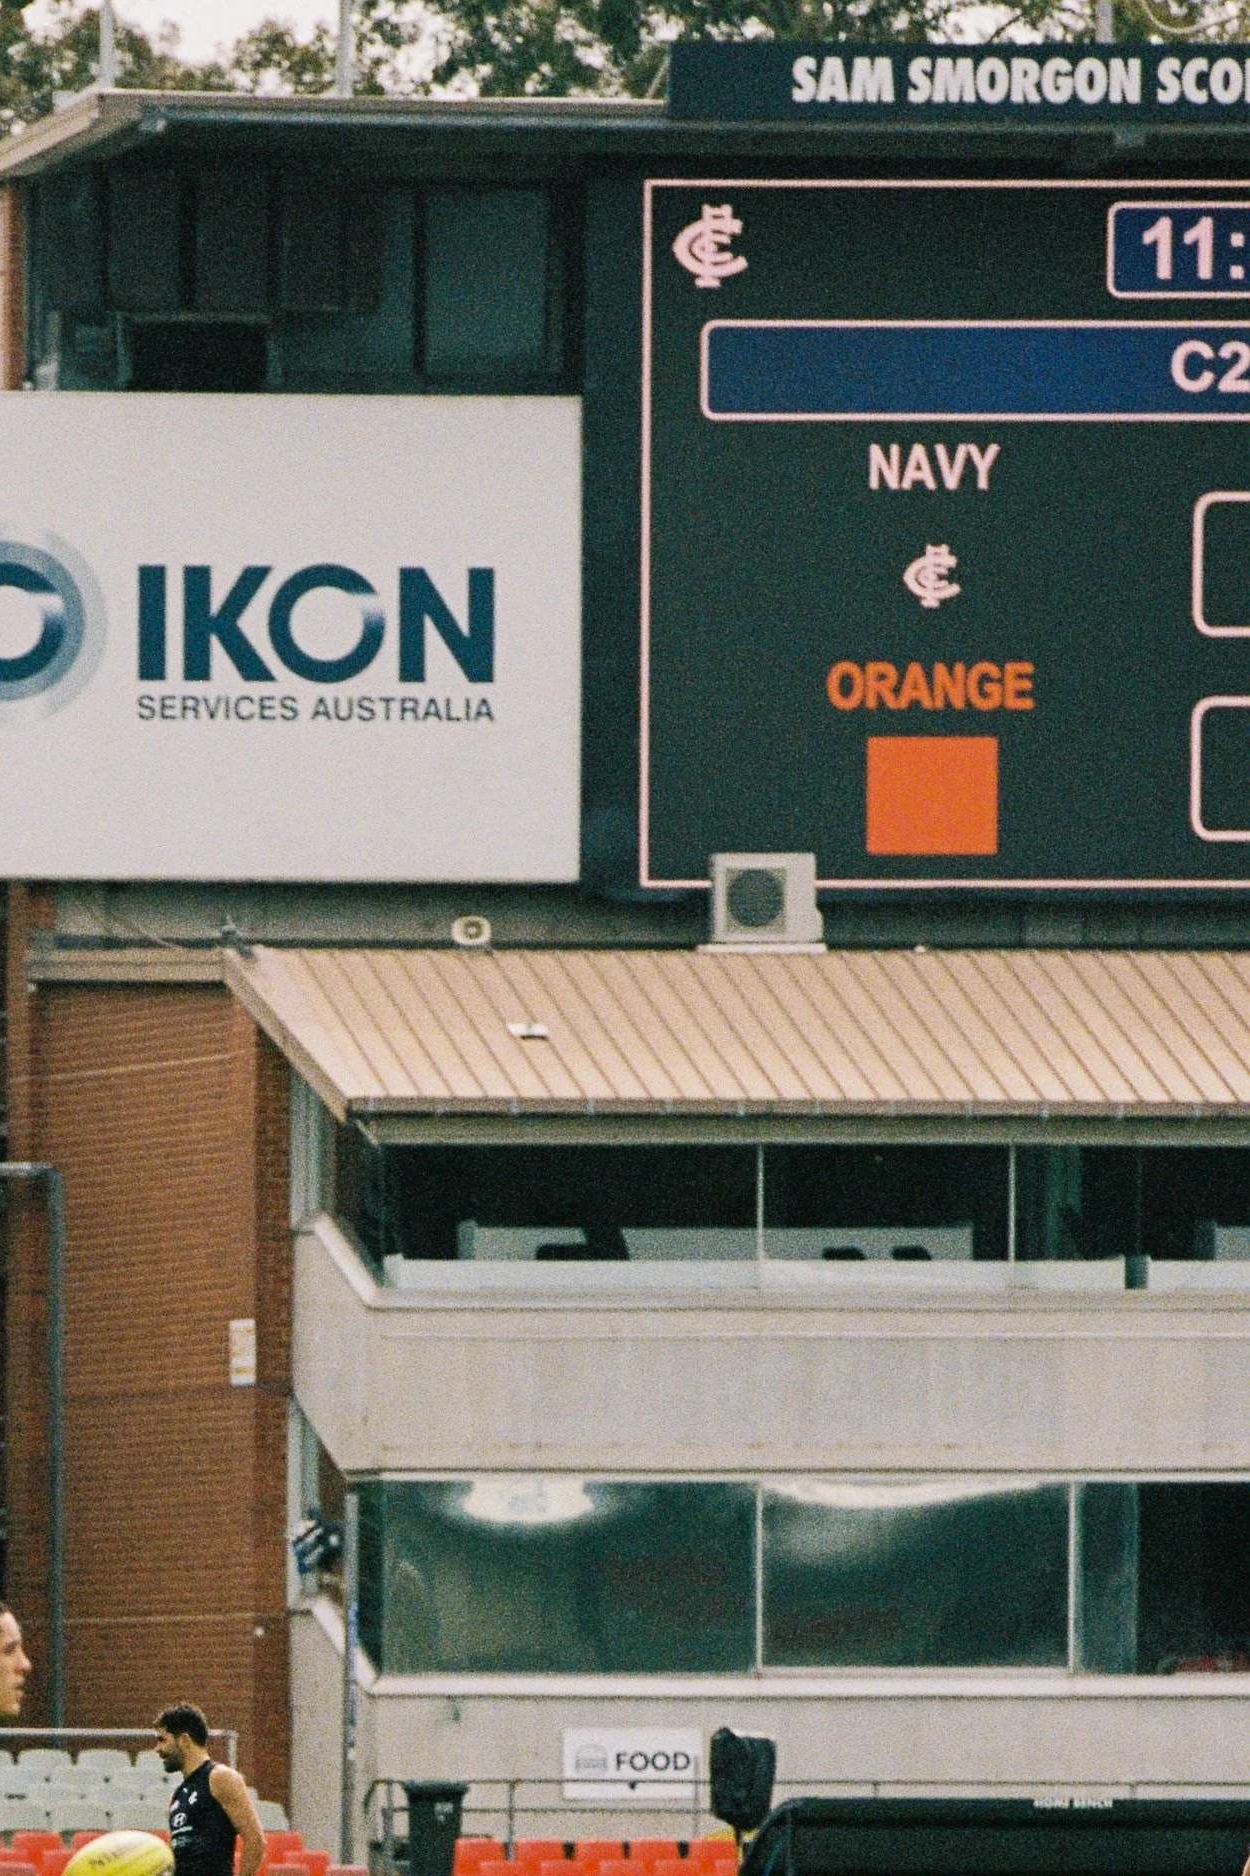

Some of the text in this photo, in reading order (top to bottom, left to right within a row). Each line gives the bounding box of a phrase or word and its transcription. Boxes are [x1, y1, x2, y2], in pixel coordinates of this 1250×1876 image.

[792, 57, 1250, 104] SAM SMORGON SCO
[1142, 216, 1246, 280] 11:
[1171, 339, 1250, 393] C2
[868, 443, 1001, 491] NAVY
[137, 563, 495, 684] IKON
[137, 694, 495, 722] SERVICES AUSTRALIA
[826, 661, 1035, 711] ORANGE
[615, 1751, 690, 1771] FOOD
